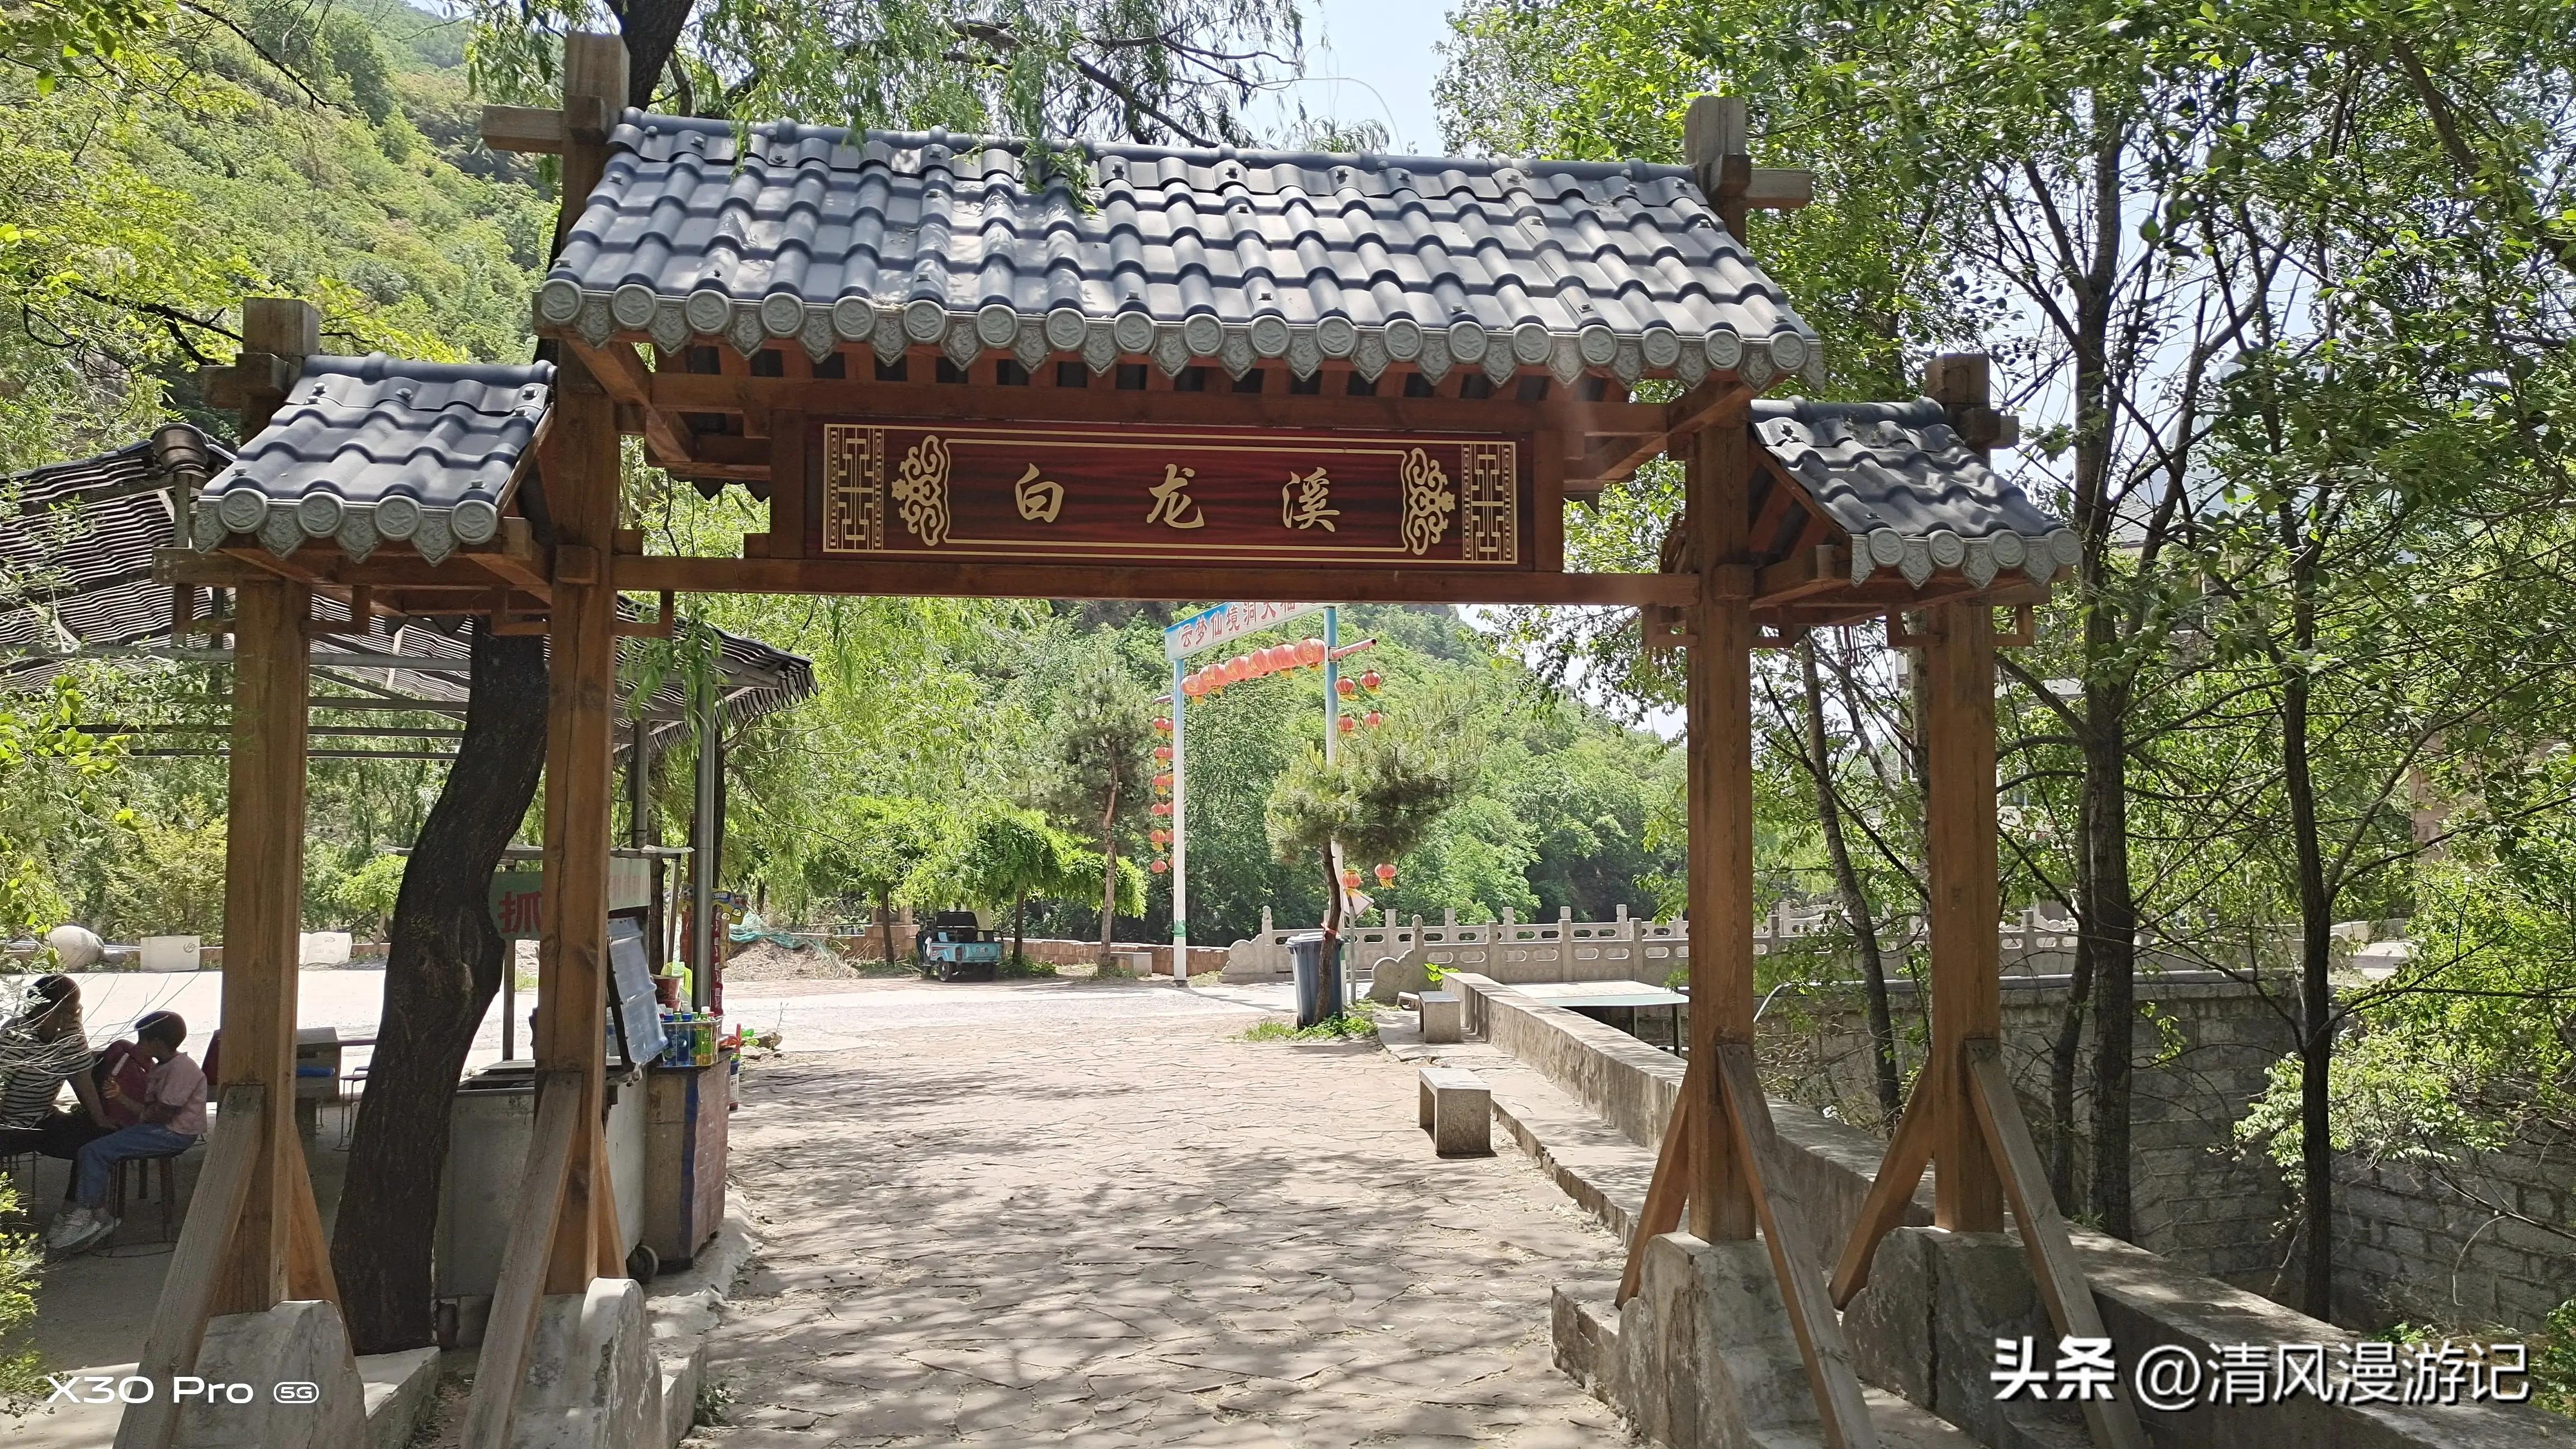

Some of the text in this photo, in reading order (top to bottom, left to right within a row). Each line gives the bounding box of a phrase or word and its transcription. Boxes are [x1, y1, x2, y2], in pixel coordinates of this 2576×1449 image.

[1015, 463, 1341, 532] 白龙溪
[1180, 602, 1317, 649] 云梦仙境洞天
[498, 892, 541, 933] 抓
